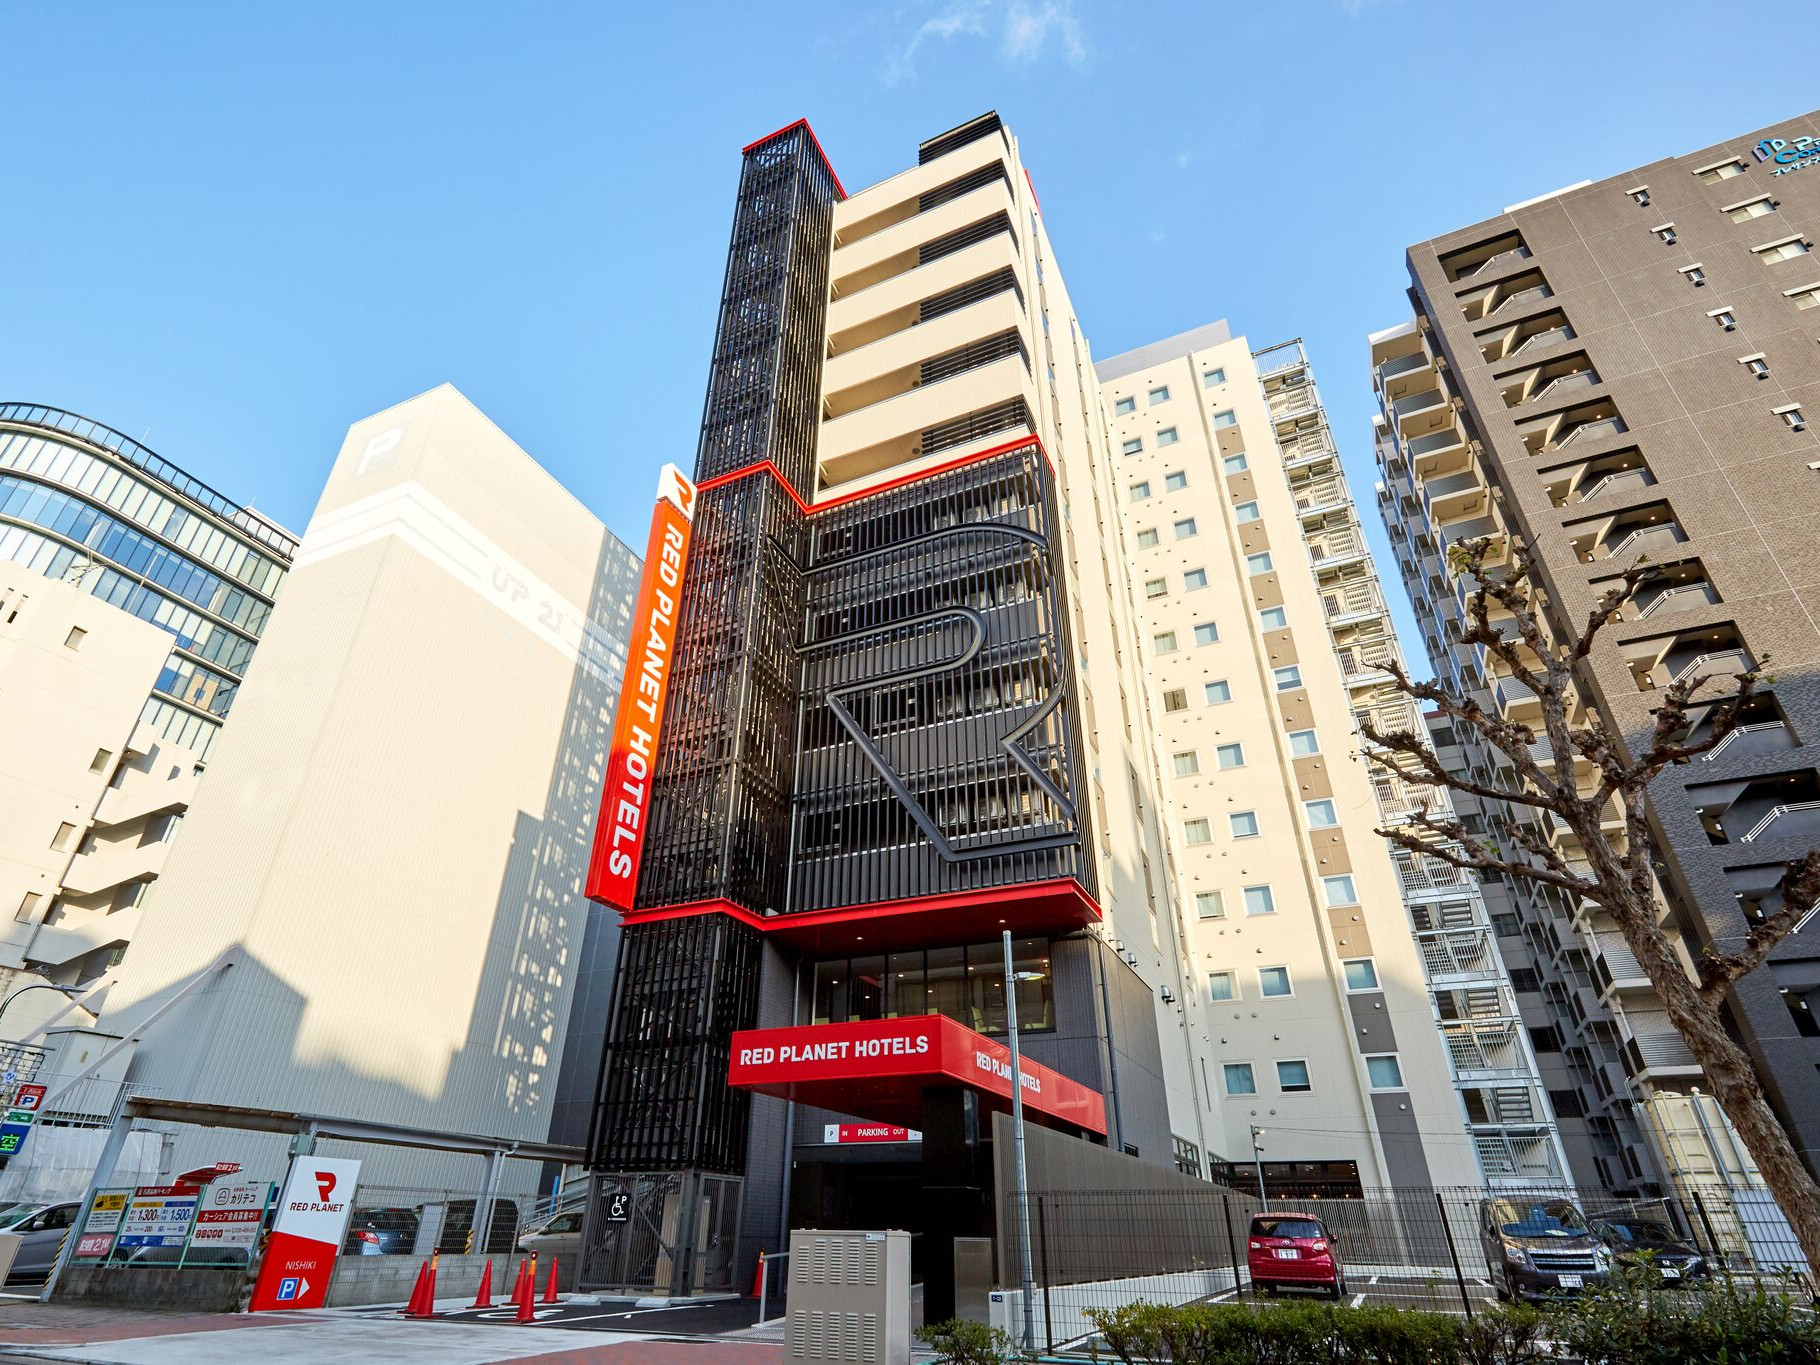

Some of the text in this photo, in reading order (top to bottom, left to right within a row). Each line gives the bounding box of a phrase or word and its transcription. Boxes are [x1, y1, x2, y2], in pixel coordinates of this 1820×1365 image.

[356, 426, 403, 478] P
[609, 521, 684, 879] RED PLANET HOTELS
[740, 1035, 929, 1066] RED PLANET HOTELS
[976, 1051, 992, 1072] RED
[992, 1058, 1013, 1081] PLAN
[22, 1096, 35, 1105] P
[857, 1128, 889, 1137] PARKING
[230, 1193, 256, 1205] カリテコ
[621, 1195, 627, 1204] P
[290, 1202, 345, 1213] RED PLANET
[285, 1261, 317, 1270] NISHIKI
[281, 1280, 295, 1298] P
